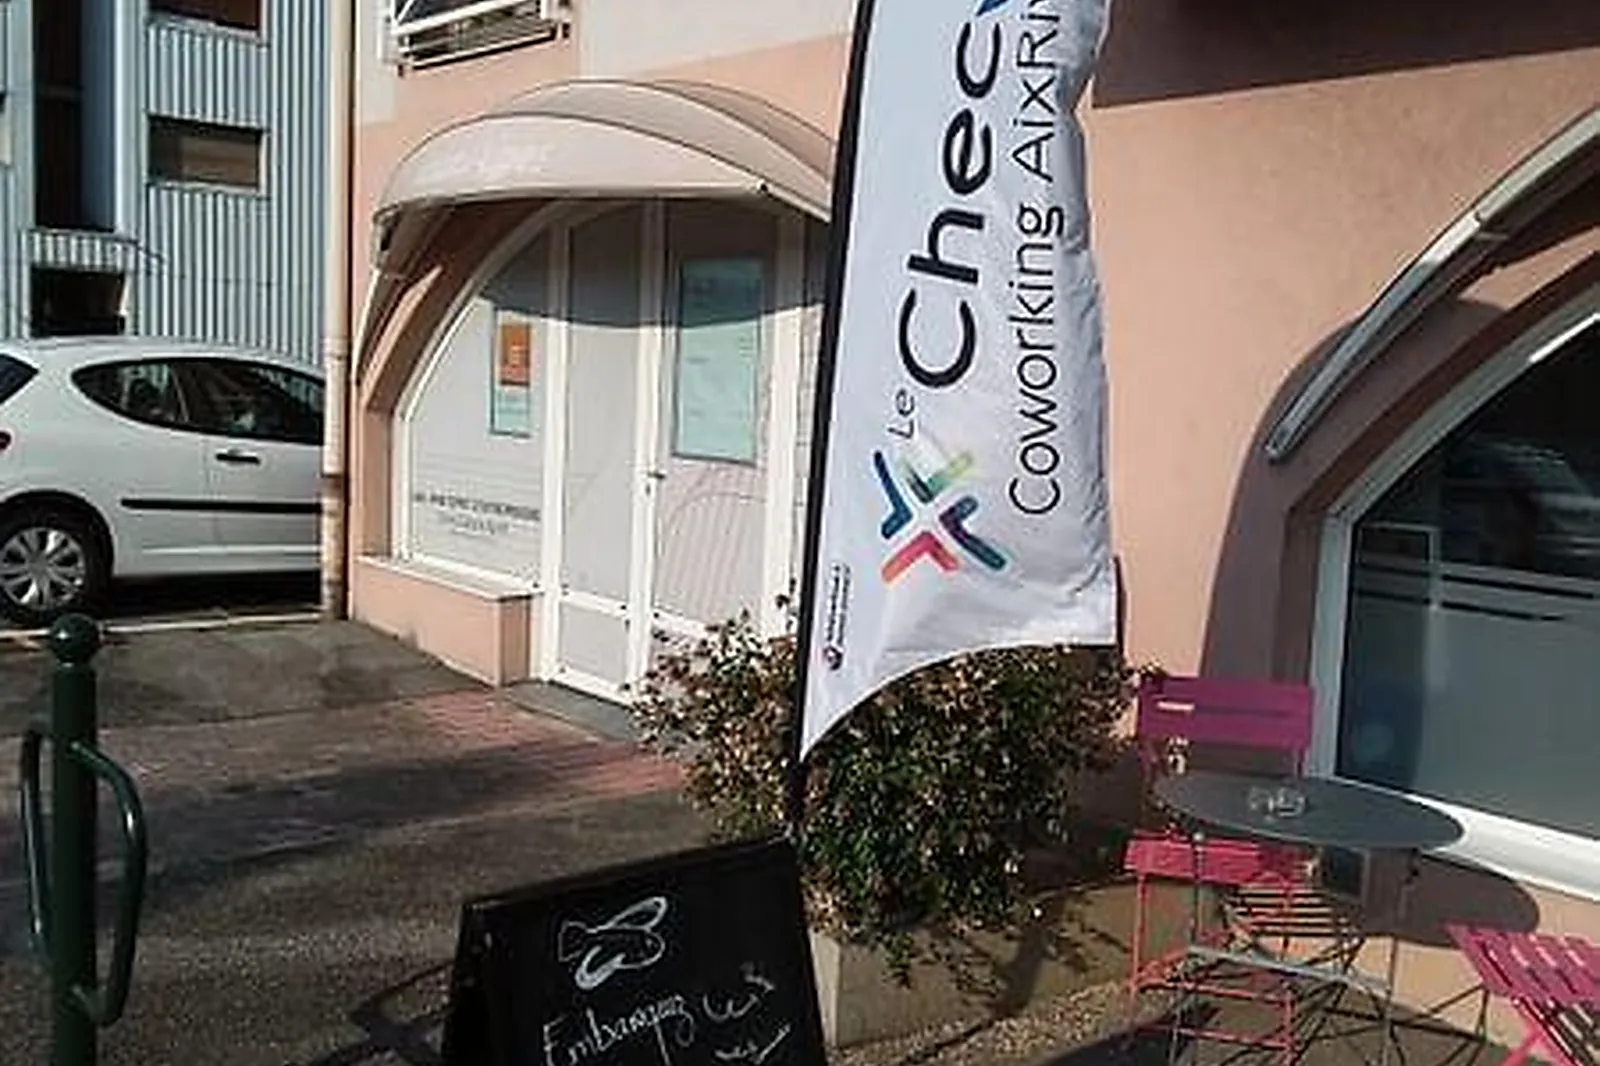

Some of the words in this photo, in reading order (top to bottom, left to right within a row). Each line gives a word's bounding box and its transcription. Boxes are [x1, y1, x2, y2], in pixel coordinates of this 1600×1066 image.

[899, 0, 1006, 389] Chec
[887, 388, 915, 439] Le
[1009, 204, 1064, 516] Coworking
